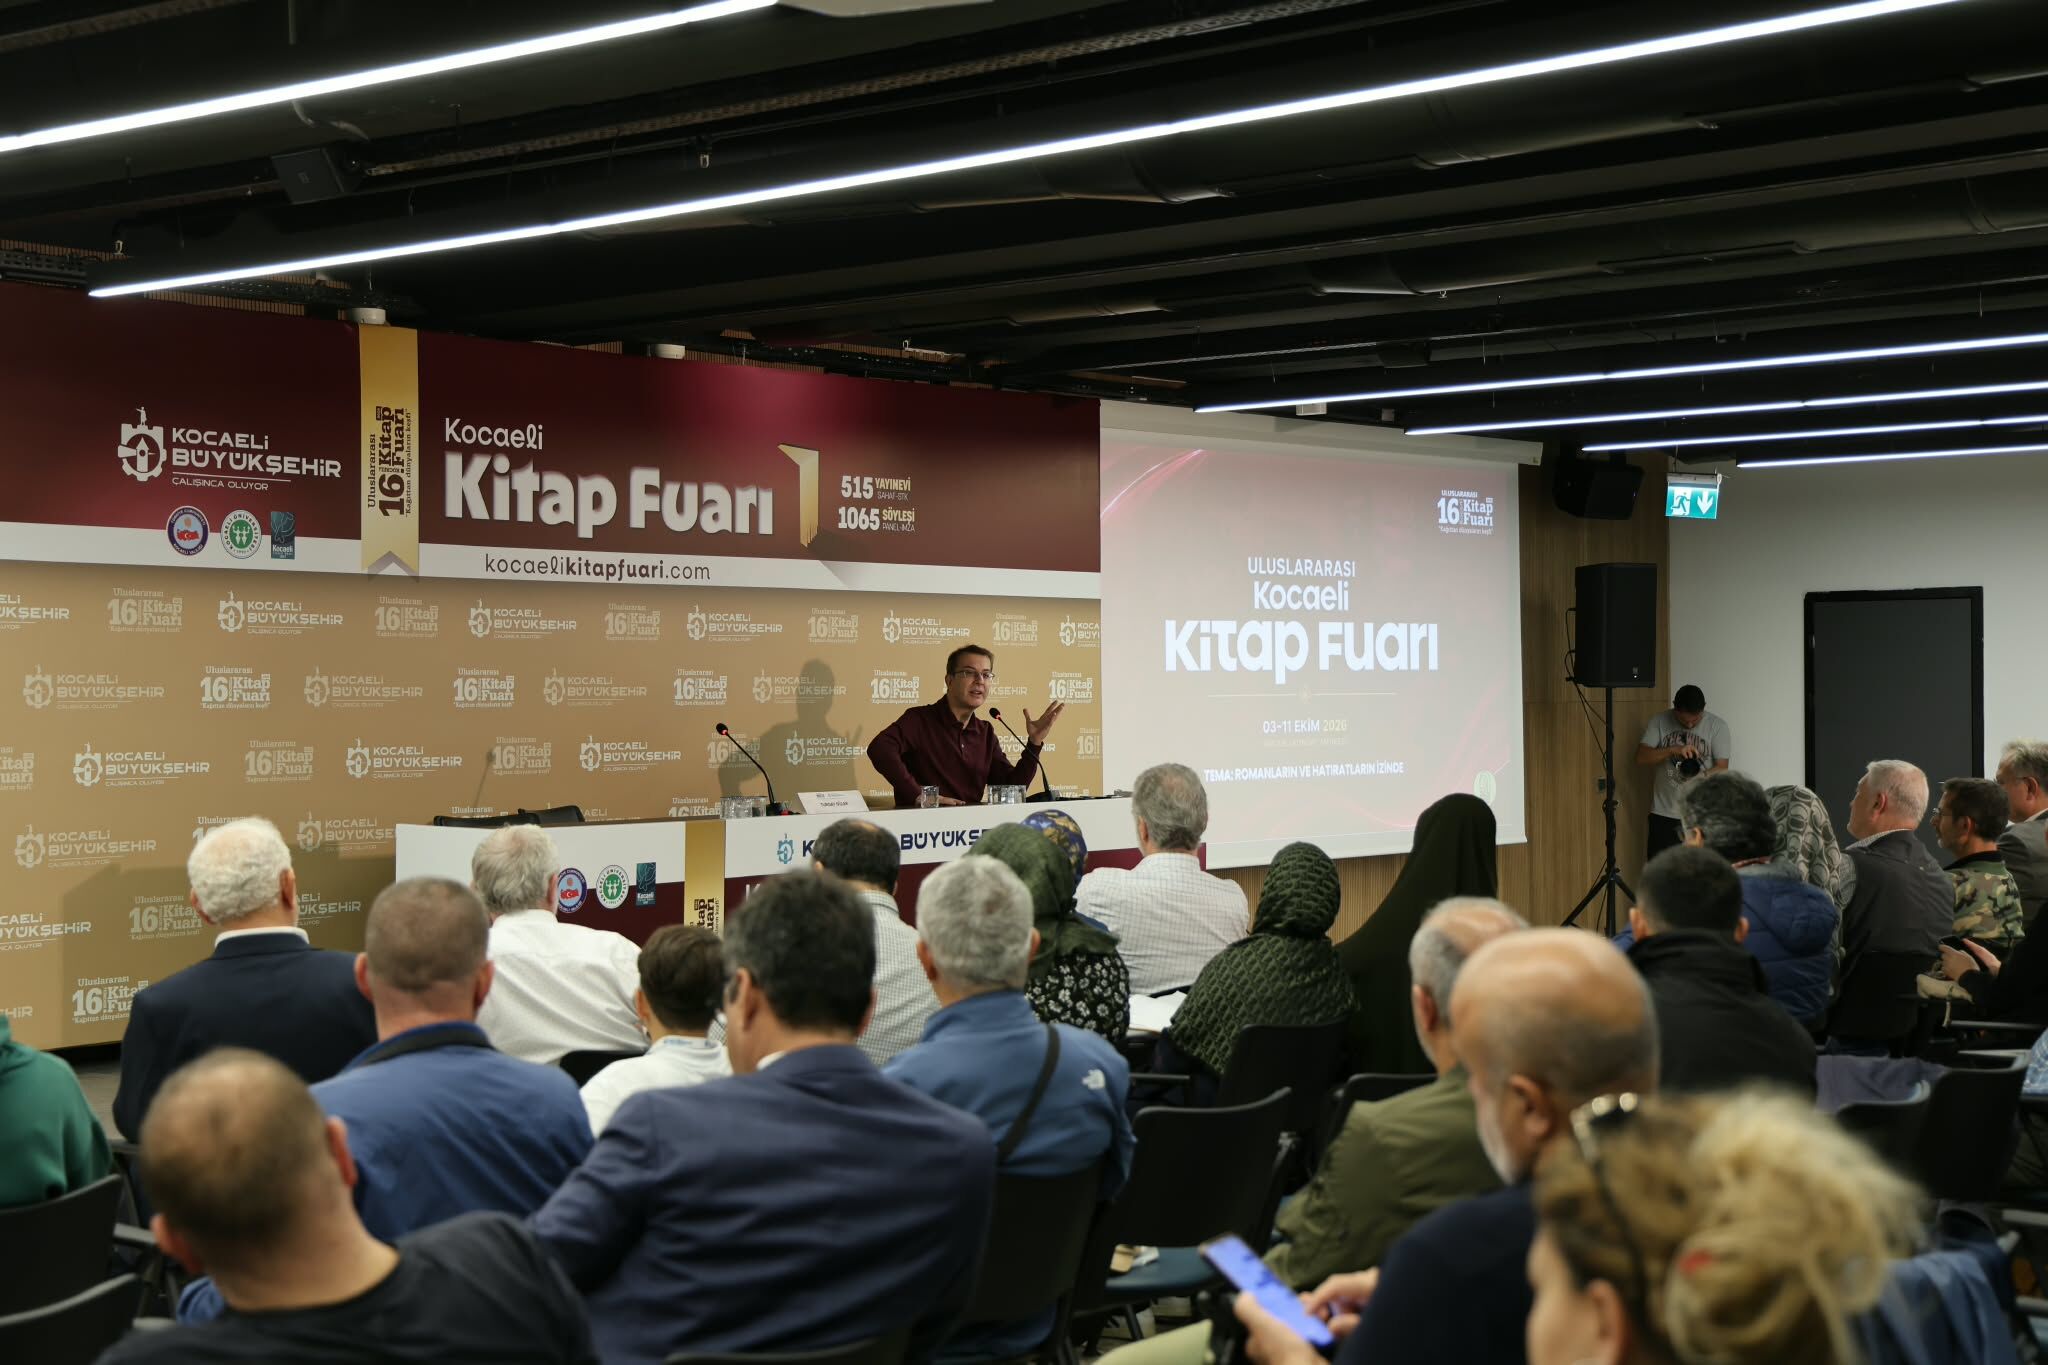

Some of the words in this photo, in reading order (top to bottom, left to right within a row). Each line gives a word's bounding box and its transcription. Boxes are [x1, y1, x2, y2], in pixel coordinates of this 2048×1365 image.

[379, 406, 394, 466] Kitap
[445, 417, 543, 450] Kocaeli
[367, 433, 376, 508] Uluslararası
[228, 481, 269, 491] OLUYOR
[445, 451, 617, 538] Kitap
[630, 466, 773, 534] Fuarı
[841, 475, 874, 499] 515
[838, 506, 880, 530] 1065
[1437, 497, 1460, 524] 16
[1463, 498, 1493, 516] Kitap
[485, 553, 711, 581] kocaelikitapfuari.com
[1248, 556, 1356, 577] ULUSLARARASI
[1253, 581, 1349, 611] Kocaeli
[1164, 619, 1309, 684] Kitap
[1319, 621, 1439, 671] Fuarı
[233, 676, 271, 692] Kitap
[1294, 717, 1320, 733] EKİM
[1204, 768, 1234, 782] TEMA:
[1235, 766, 1298, 780] ROMANLARIN
[1300, 765, 1311, 777] VE
[1312, 762, 1375, 777] HATIRATLARIN
[107, 985, 139, 1000] Kita
